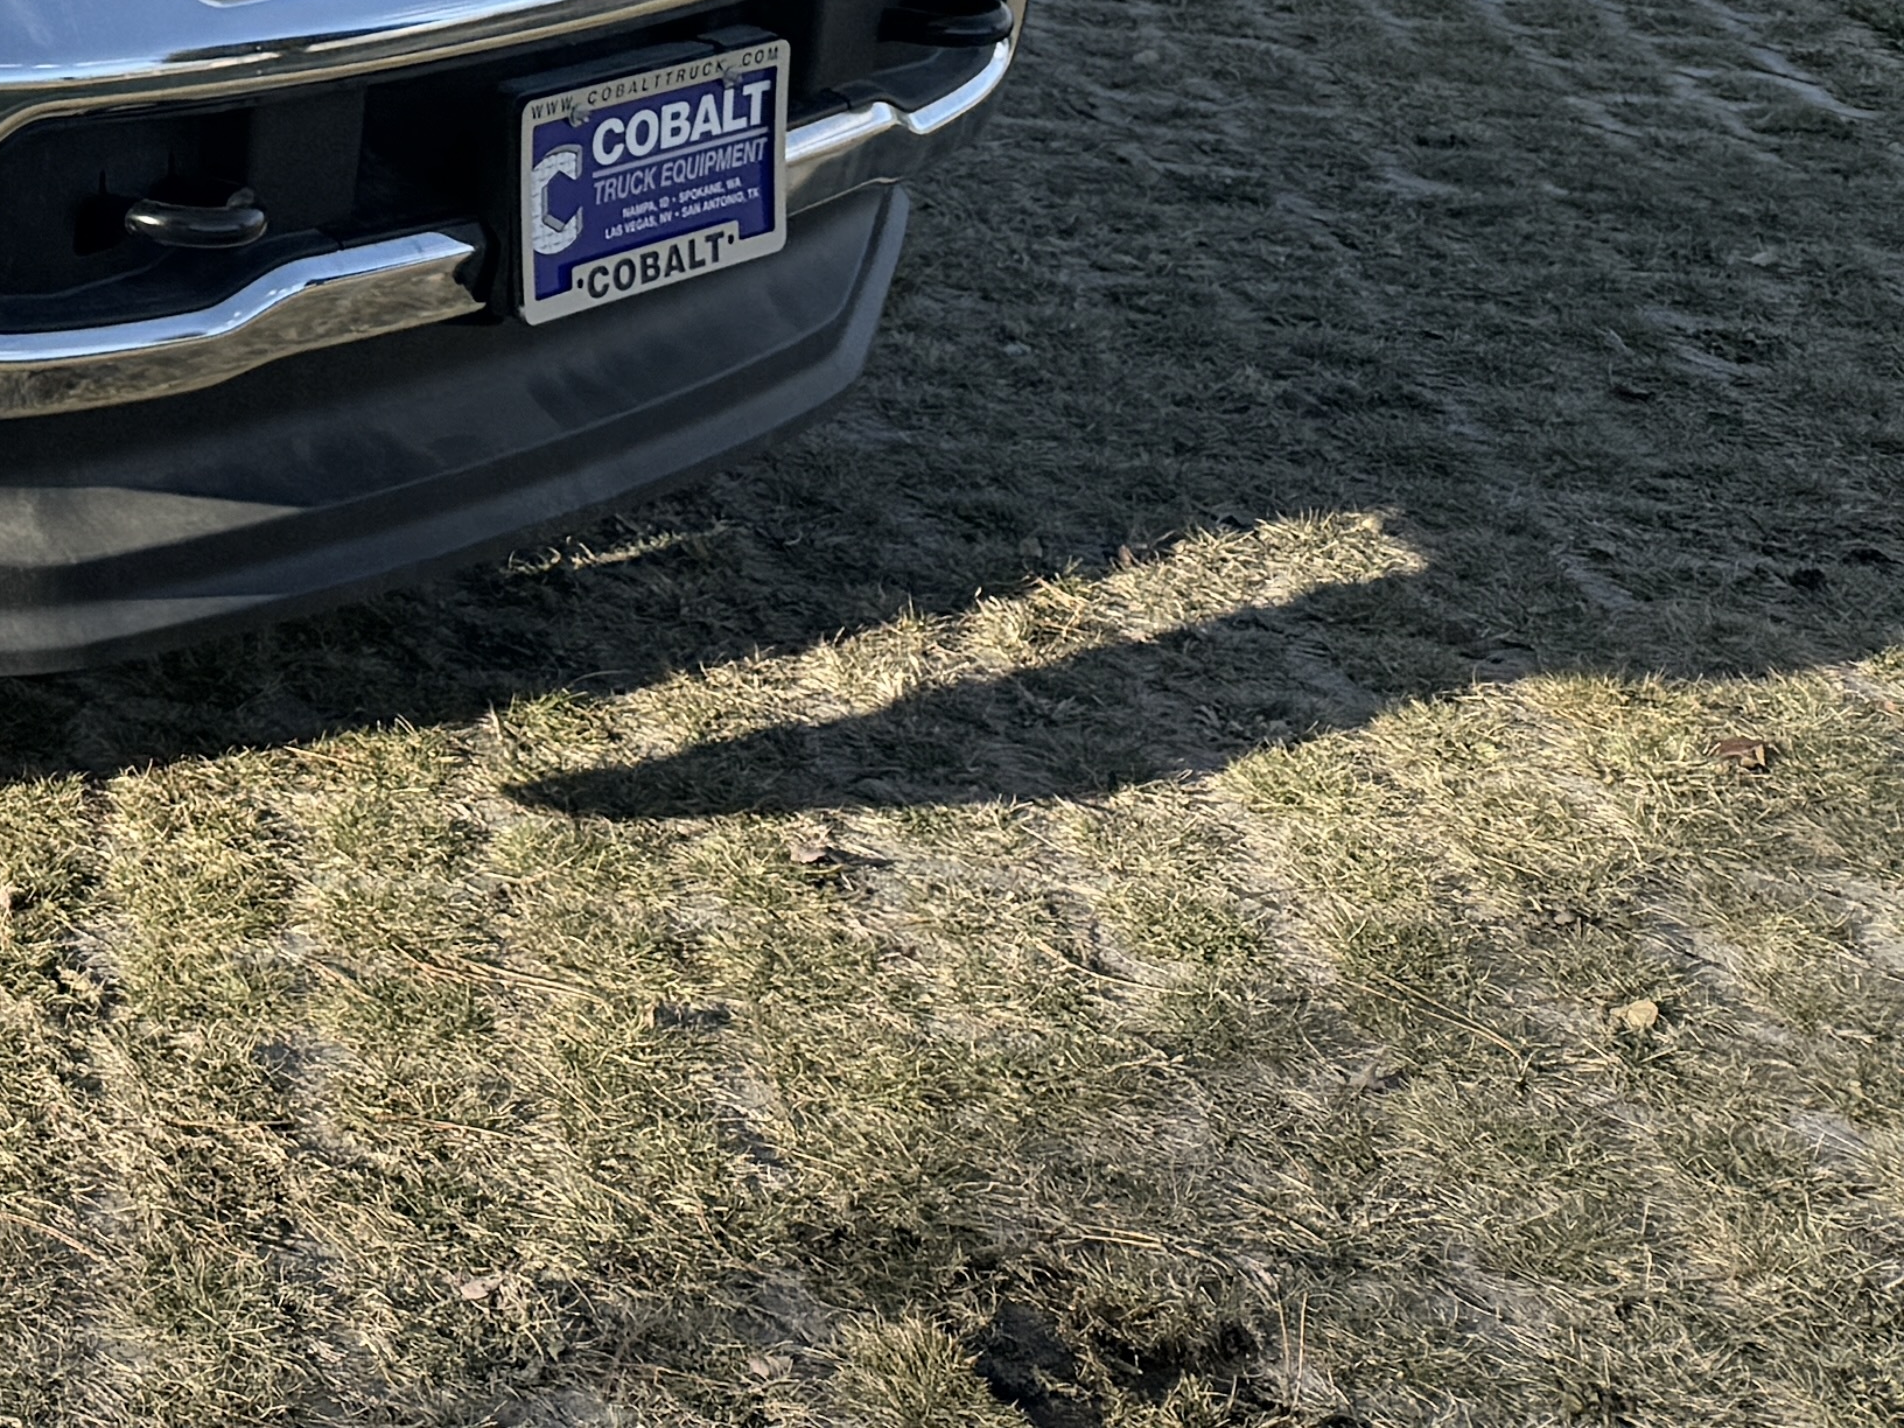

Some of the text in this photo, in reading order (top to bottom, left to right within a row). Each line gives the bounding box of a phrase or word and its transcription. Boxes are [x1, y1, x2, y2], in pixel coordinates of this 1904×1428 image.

[592, 80, 771, 166] COBALT
[594, 137, 768, 206] TRUCK EQUIPMENT
[659, 196, 670, 209] ID
[726, 176, 742, 190] WA
[605, 223, 623, 240] LAS
[682, 204, 702, 218] SAN
[587, 229, 726, 299] COBALT
